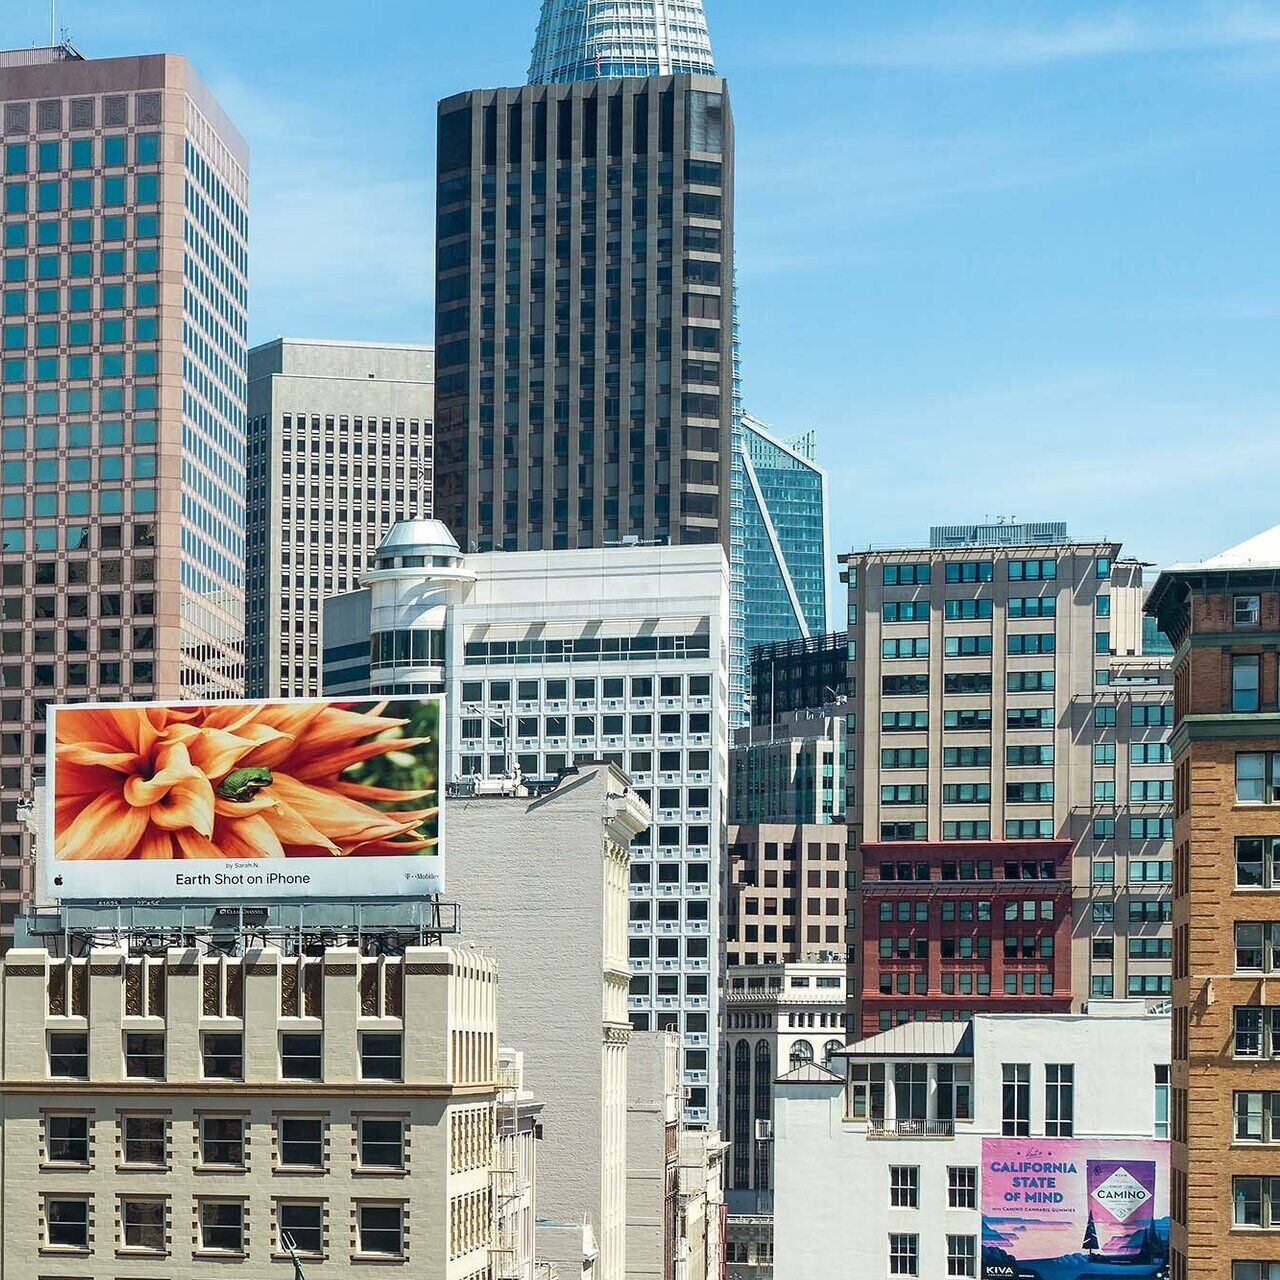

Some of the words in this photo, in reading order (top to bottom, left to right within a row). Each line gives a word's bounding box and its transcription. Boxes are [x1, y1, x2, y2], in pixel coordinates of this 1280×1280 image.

[176, 873, 211, 885] Earth
[214, 873, 244, 885] Shot
[247, 875, 263, 885] on
[266, 872, 311, 885] iPhone
[990, 1161, 1078, 1174] CALIFORNIA
[1012, 1176, 1056, 1189] STATE
[1004, 1192, 1021, 1202] OF
[1025, 1192, 1064, 1203] MIND
[1097, 1190, 1146, 1200] CAMINO
[986, 1266, 1014, 1275] KIVA
